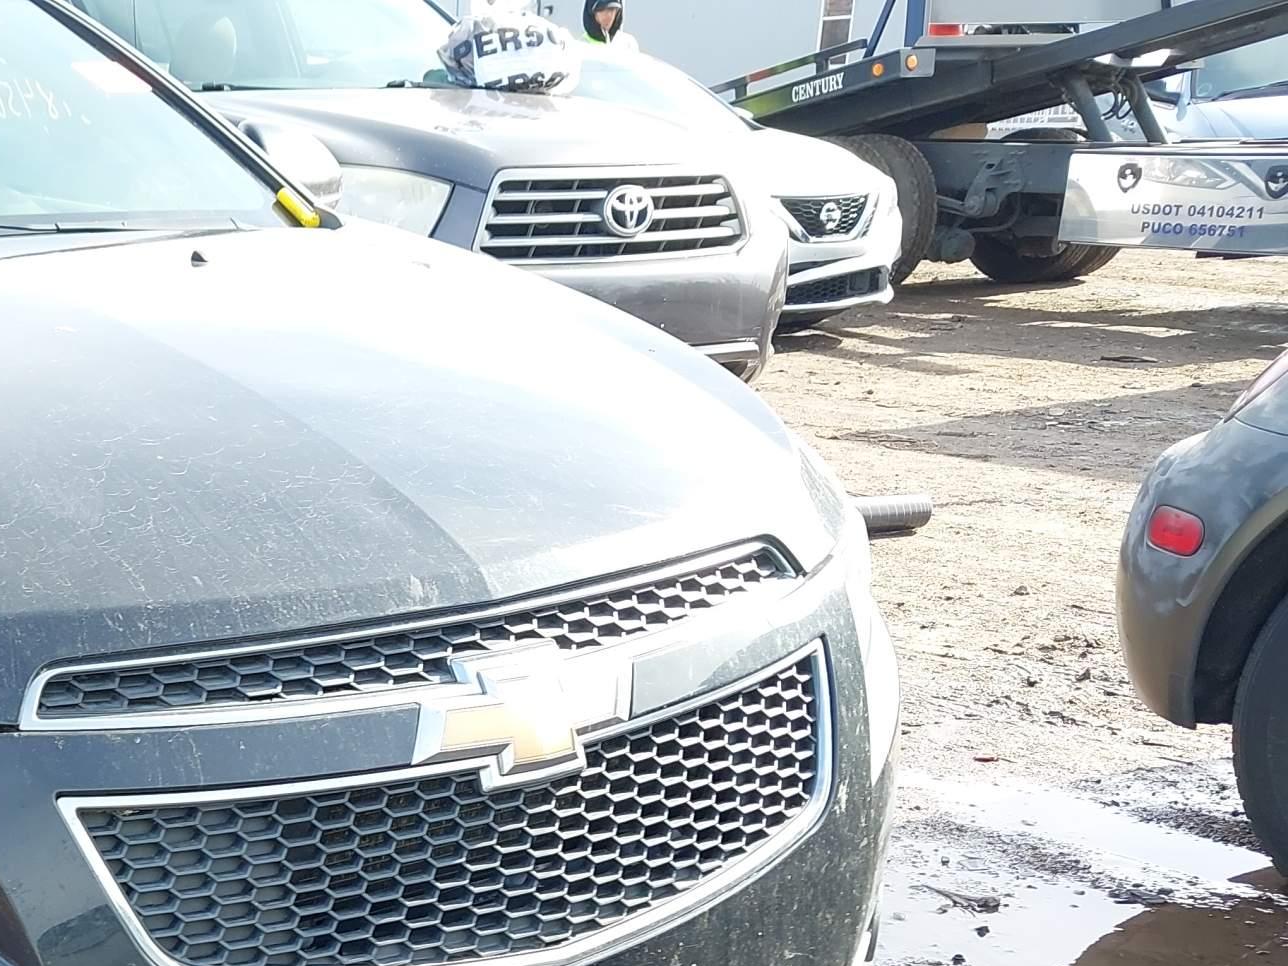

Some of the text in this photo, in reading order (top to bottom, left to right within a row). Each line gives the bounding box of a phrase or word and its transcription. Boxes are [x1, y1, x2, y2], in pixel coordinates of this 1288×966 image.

[791, 71, 845, 103] CENTURY
[1130, 203, 1265, 219] USDOT 04104211
[1140, 221, 1246, 238] PUCO 656751
